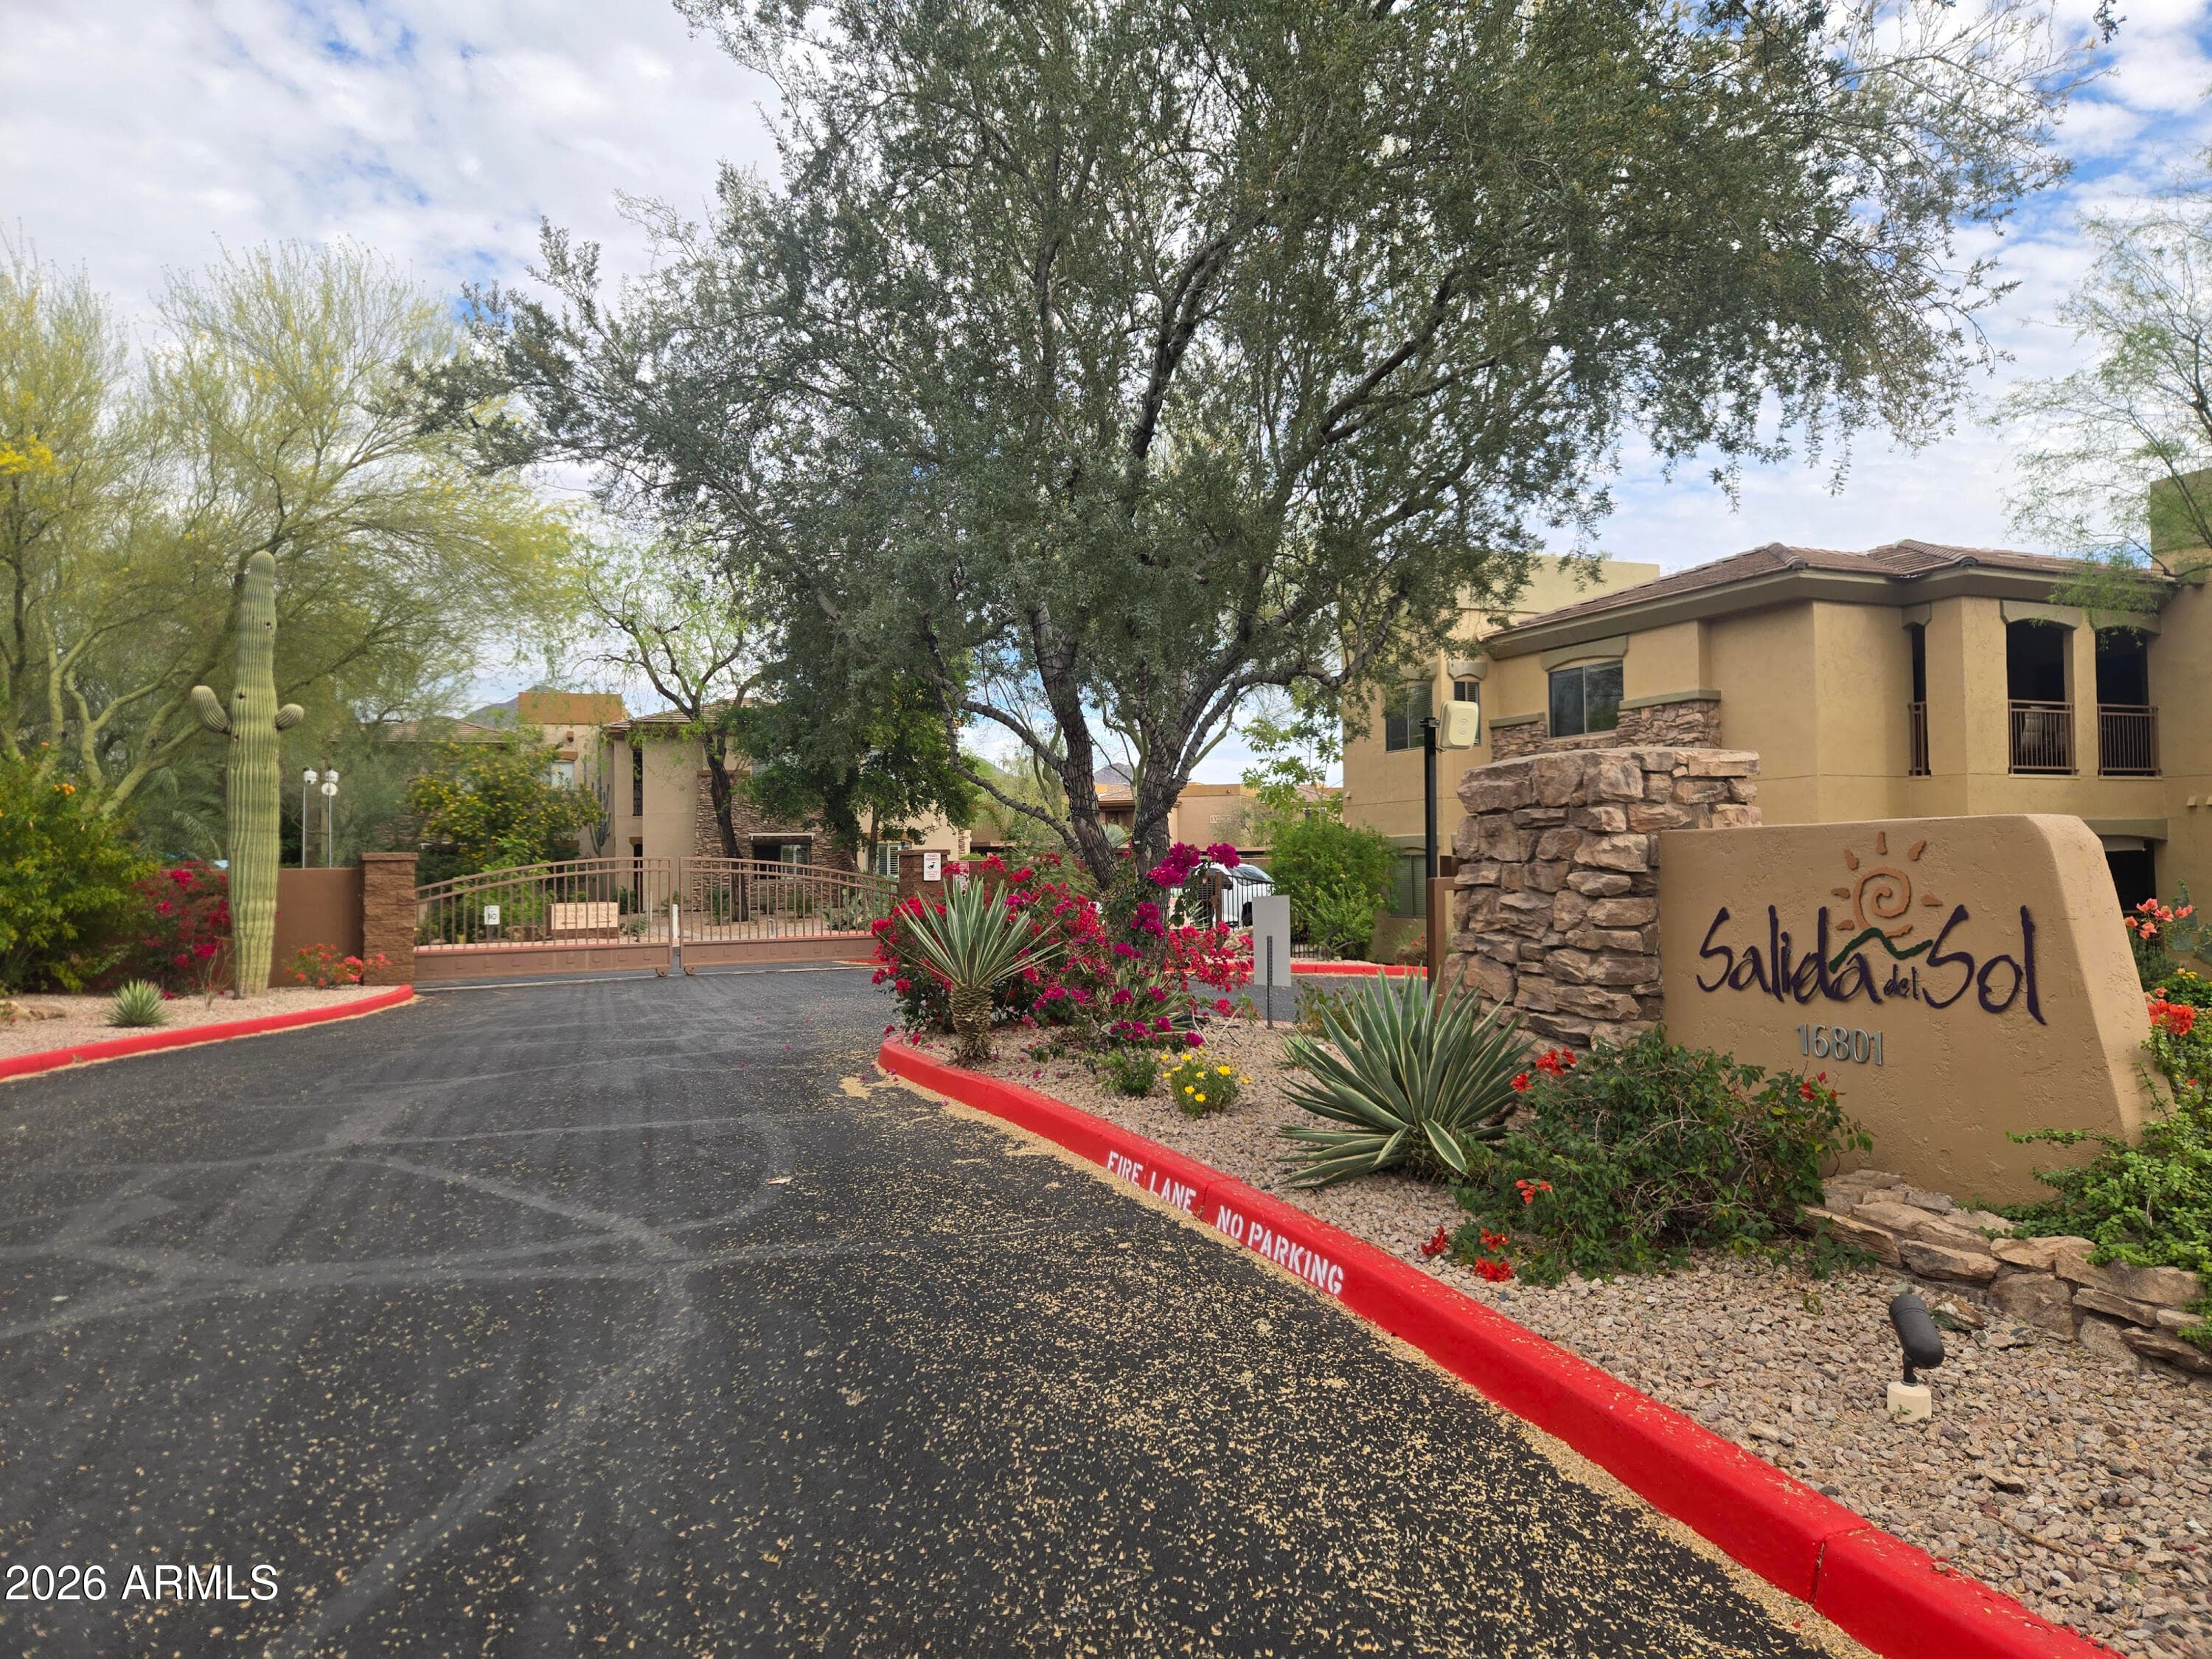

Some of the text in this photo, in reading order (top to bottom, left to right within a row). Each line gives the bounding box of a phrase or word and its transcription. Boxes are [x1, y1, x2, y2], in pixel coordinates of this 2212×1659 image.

[1697, 904, 2046, 1025] Salida del Sol
[1796, 1023, 1884, 1066] 16801
[1107, 1150, 1344, 1295] FIRE LANE NO PARKING
